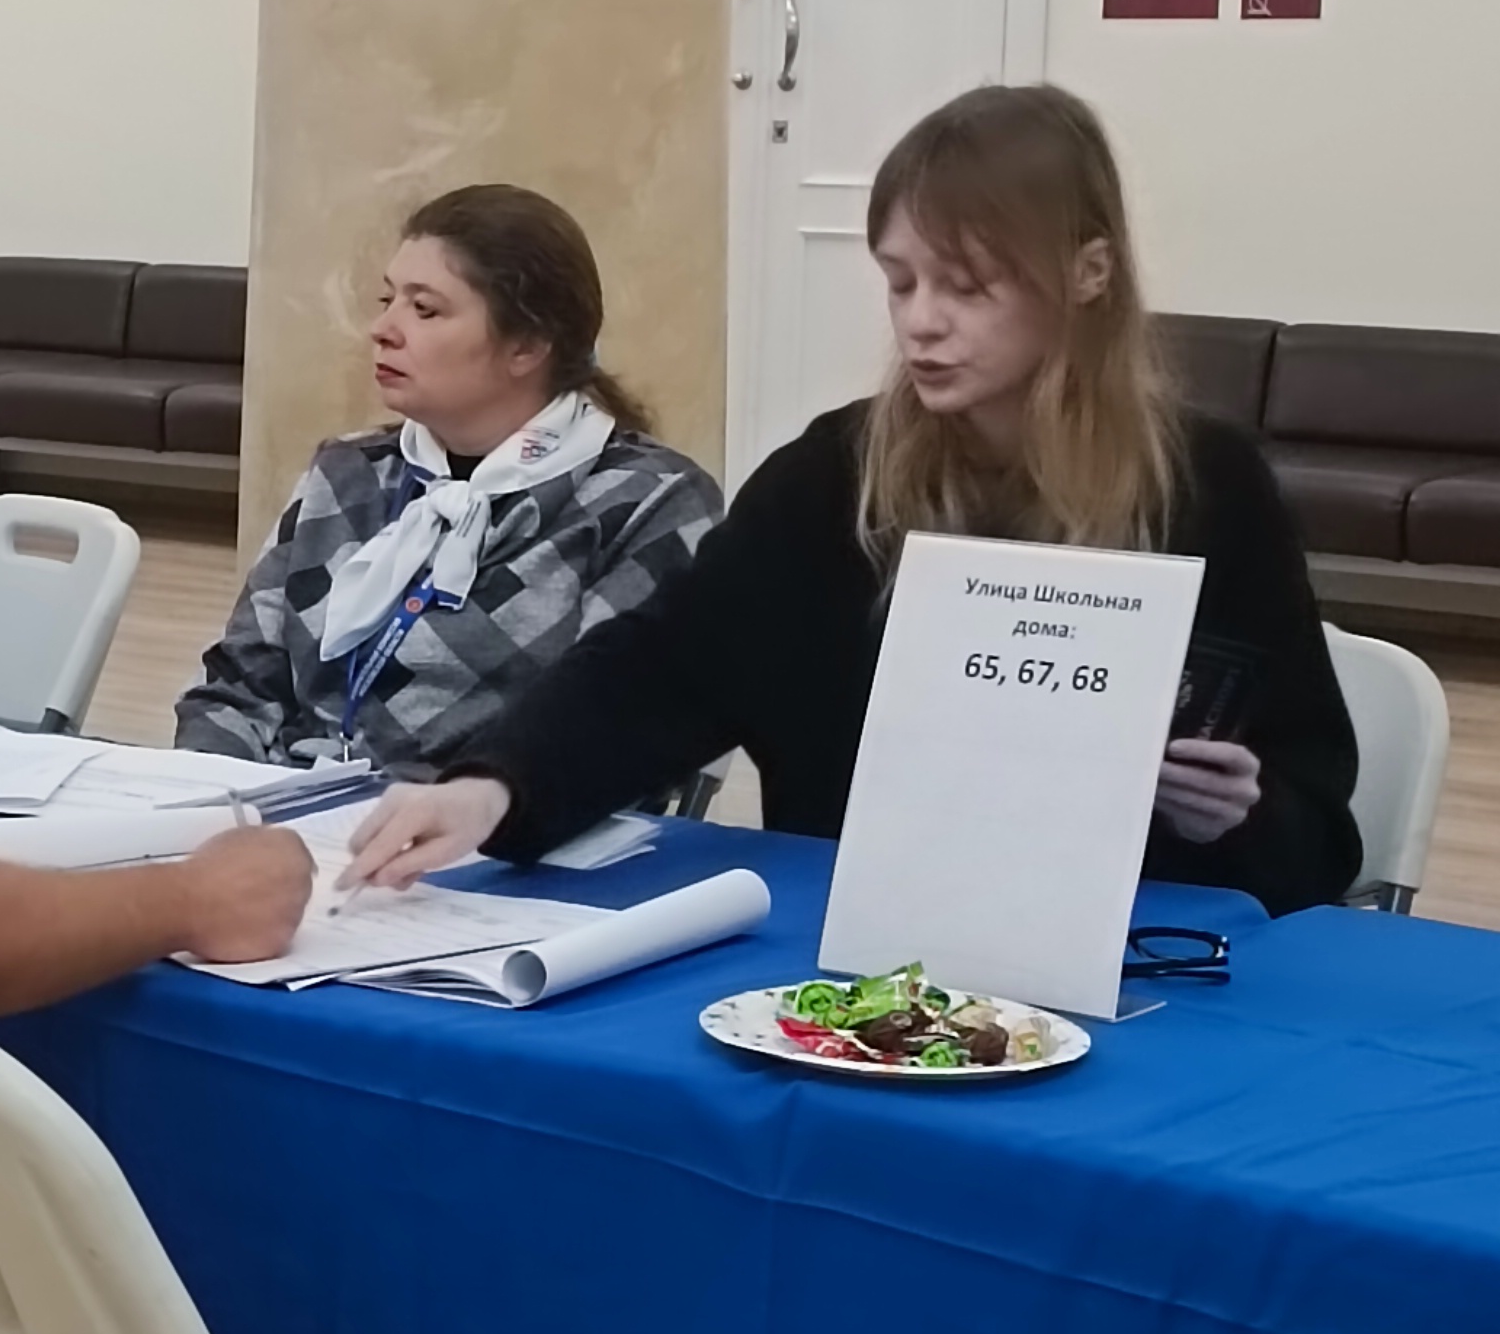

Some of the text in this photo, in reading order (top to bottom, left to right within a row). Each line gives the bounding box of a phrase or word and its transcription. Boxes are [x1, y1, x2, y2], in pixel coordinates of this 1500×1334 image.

[965, 577, 1143, 612] Улица Школьная
[1011, 620, 1077, 640] дома:
[964, 653, 1109, 693] 65, 67, 68
